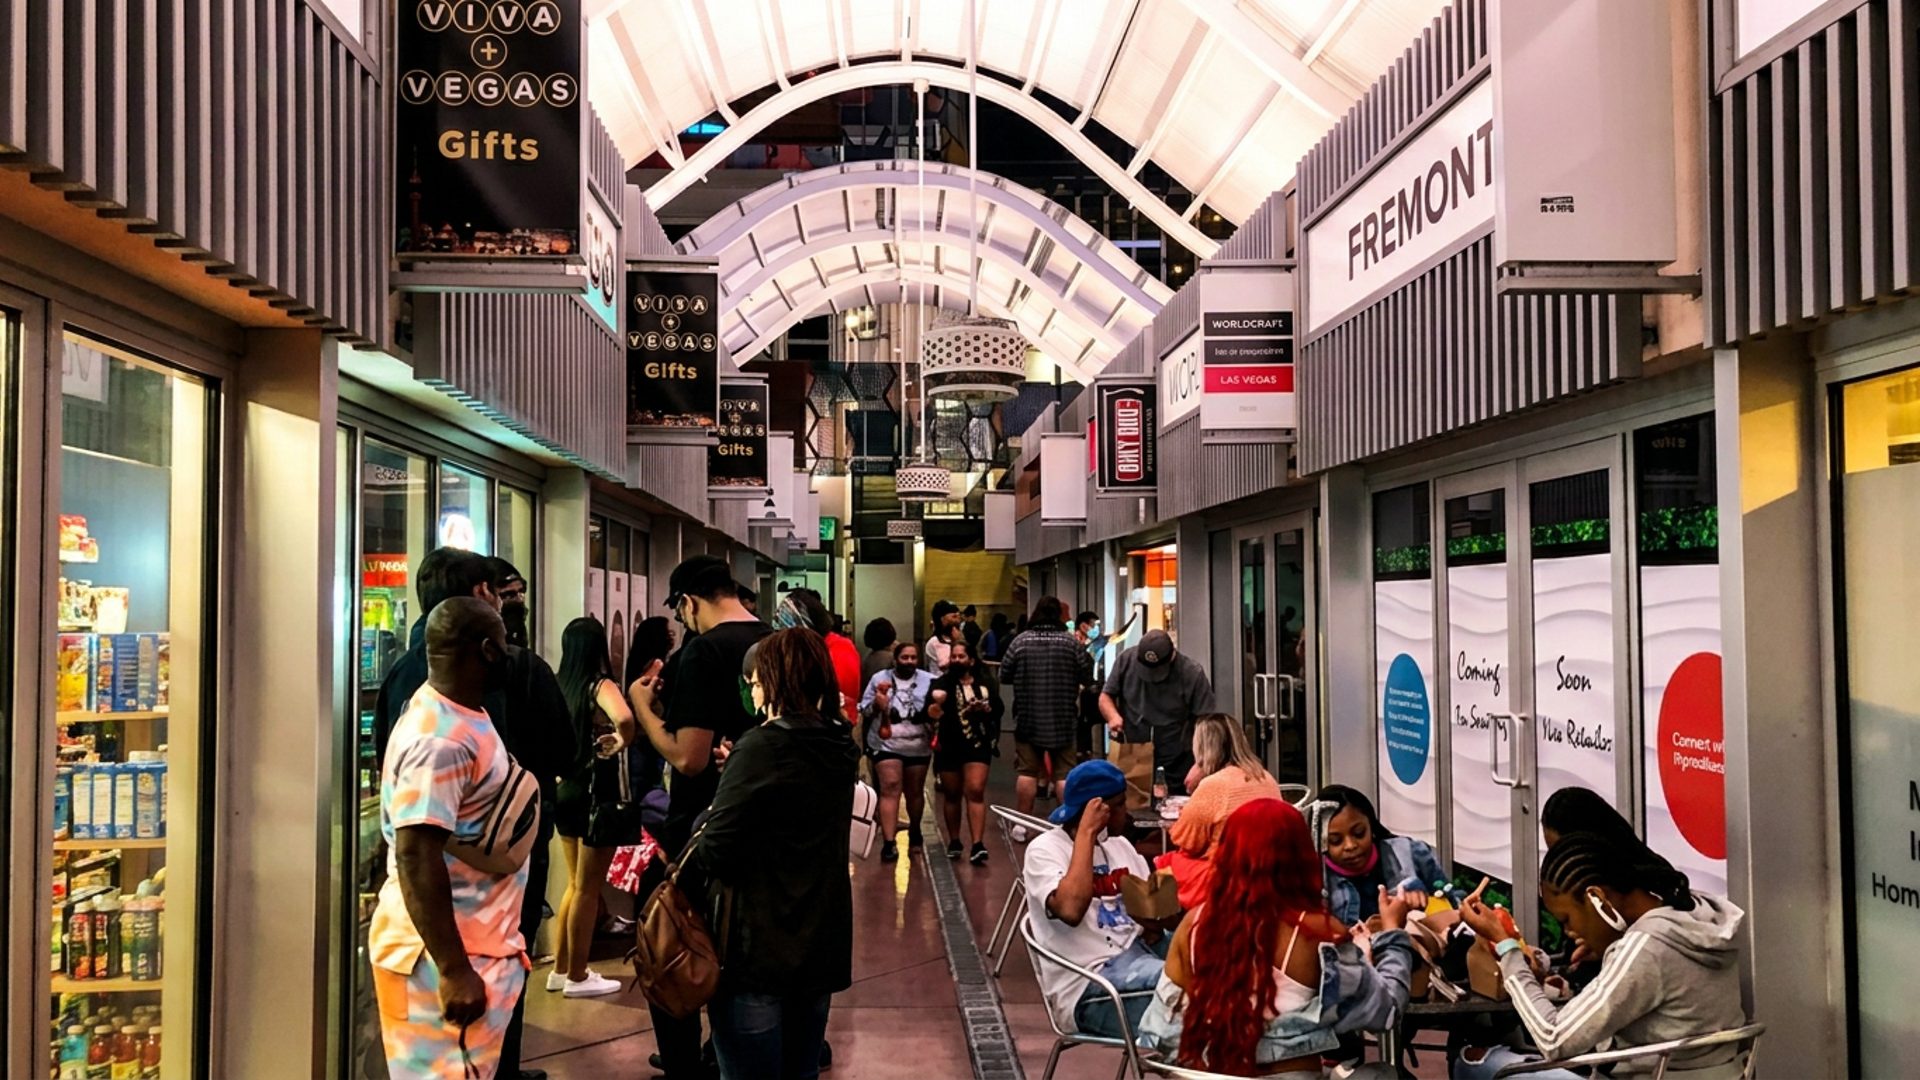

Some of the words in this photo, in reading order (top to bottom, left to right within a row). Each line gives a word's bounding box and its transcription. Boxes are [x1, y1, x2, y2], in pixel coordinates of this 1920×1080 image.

[422, 3, 555, 28] VIVA
[406, 76, 570, 101] VEGAS
[438, 130, 539, 160] Gifts
[1348, 118, 1494, 281] FREMONT
[629, 334, 713, 349] VEGAS
[1220, 375, 1240, 385] LAS
[718, 442, 754, 456] Gifts
[1456, 650, 1501, 697] Coming
[1556, 655, 1592, 692] Soon
